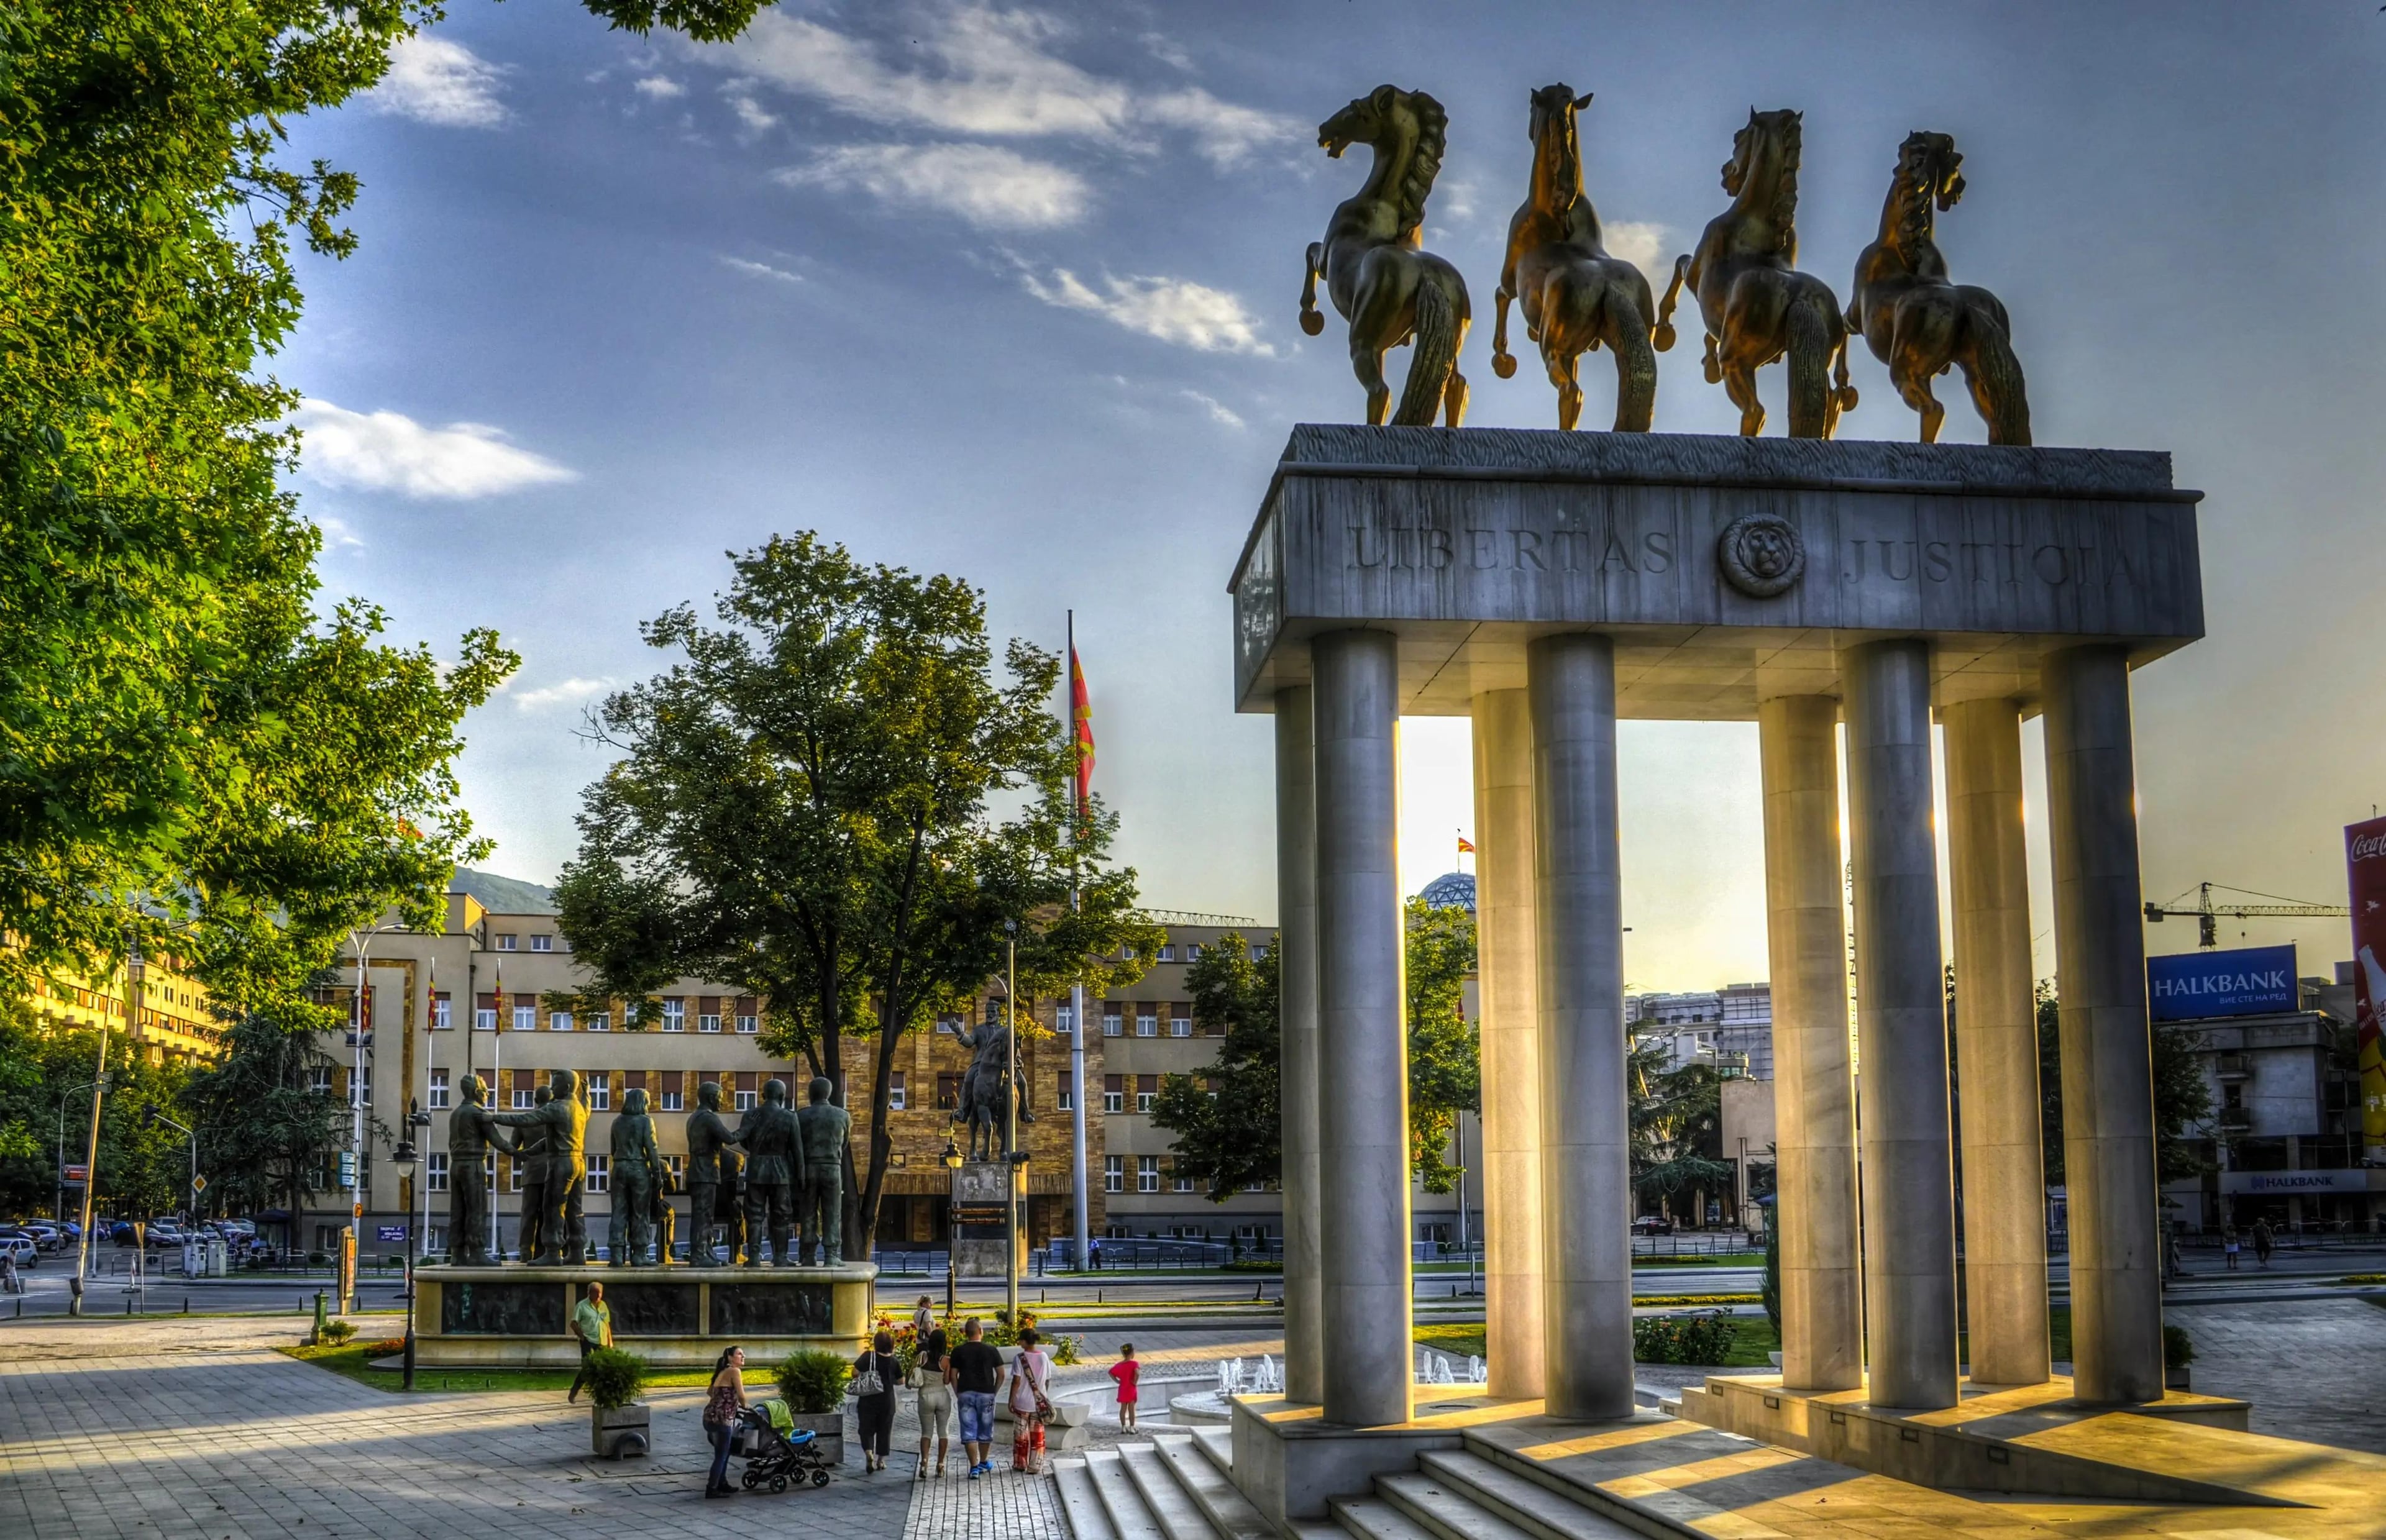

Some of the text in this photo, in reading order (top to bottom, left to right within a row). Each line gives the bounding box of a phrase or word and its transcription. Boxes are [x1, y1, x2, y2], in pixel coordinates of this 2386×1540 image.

[1346, 526, 1673, 574] LIBERTAS
[2155, 970, 2287, 997] HALKBANK
[2219, 993, 2287, 1005] ВИЕ СТЕ НА РЕД
[2265, 1176, 2334, 1188] HALKBANK
